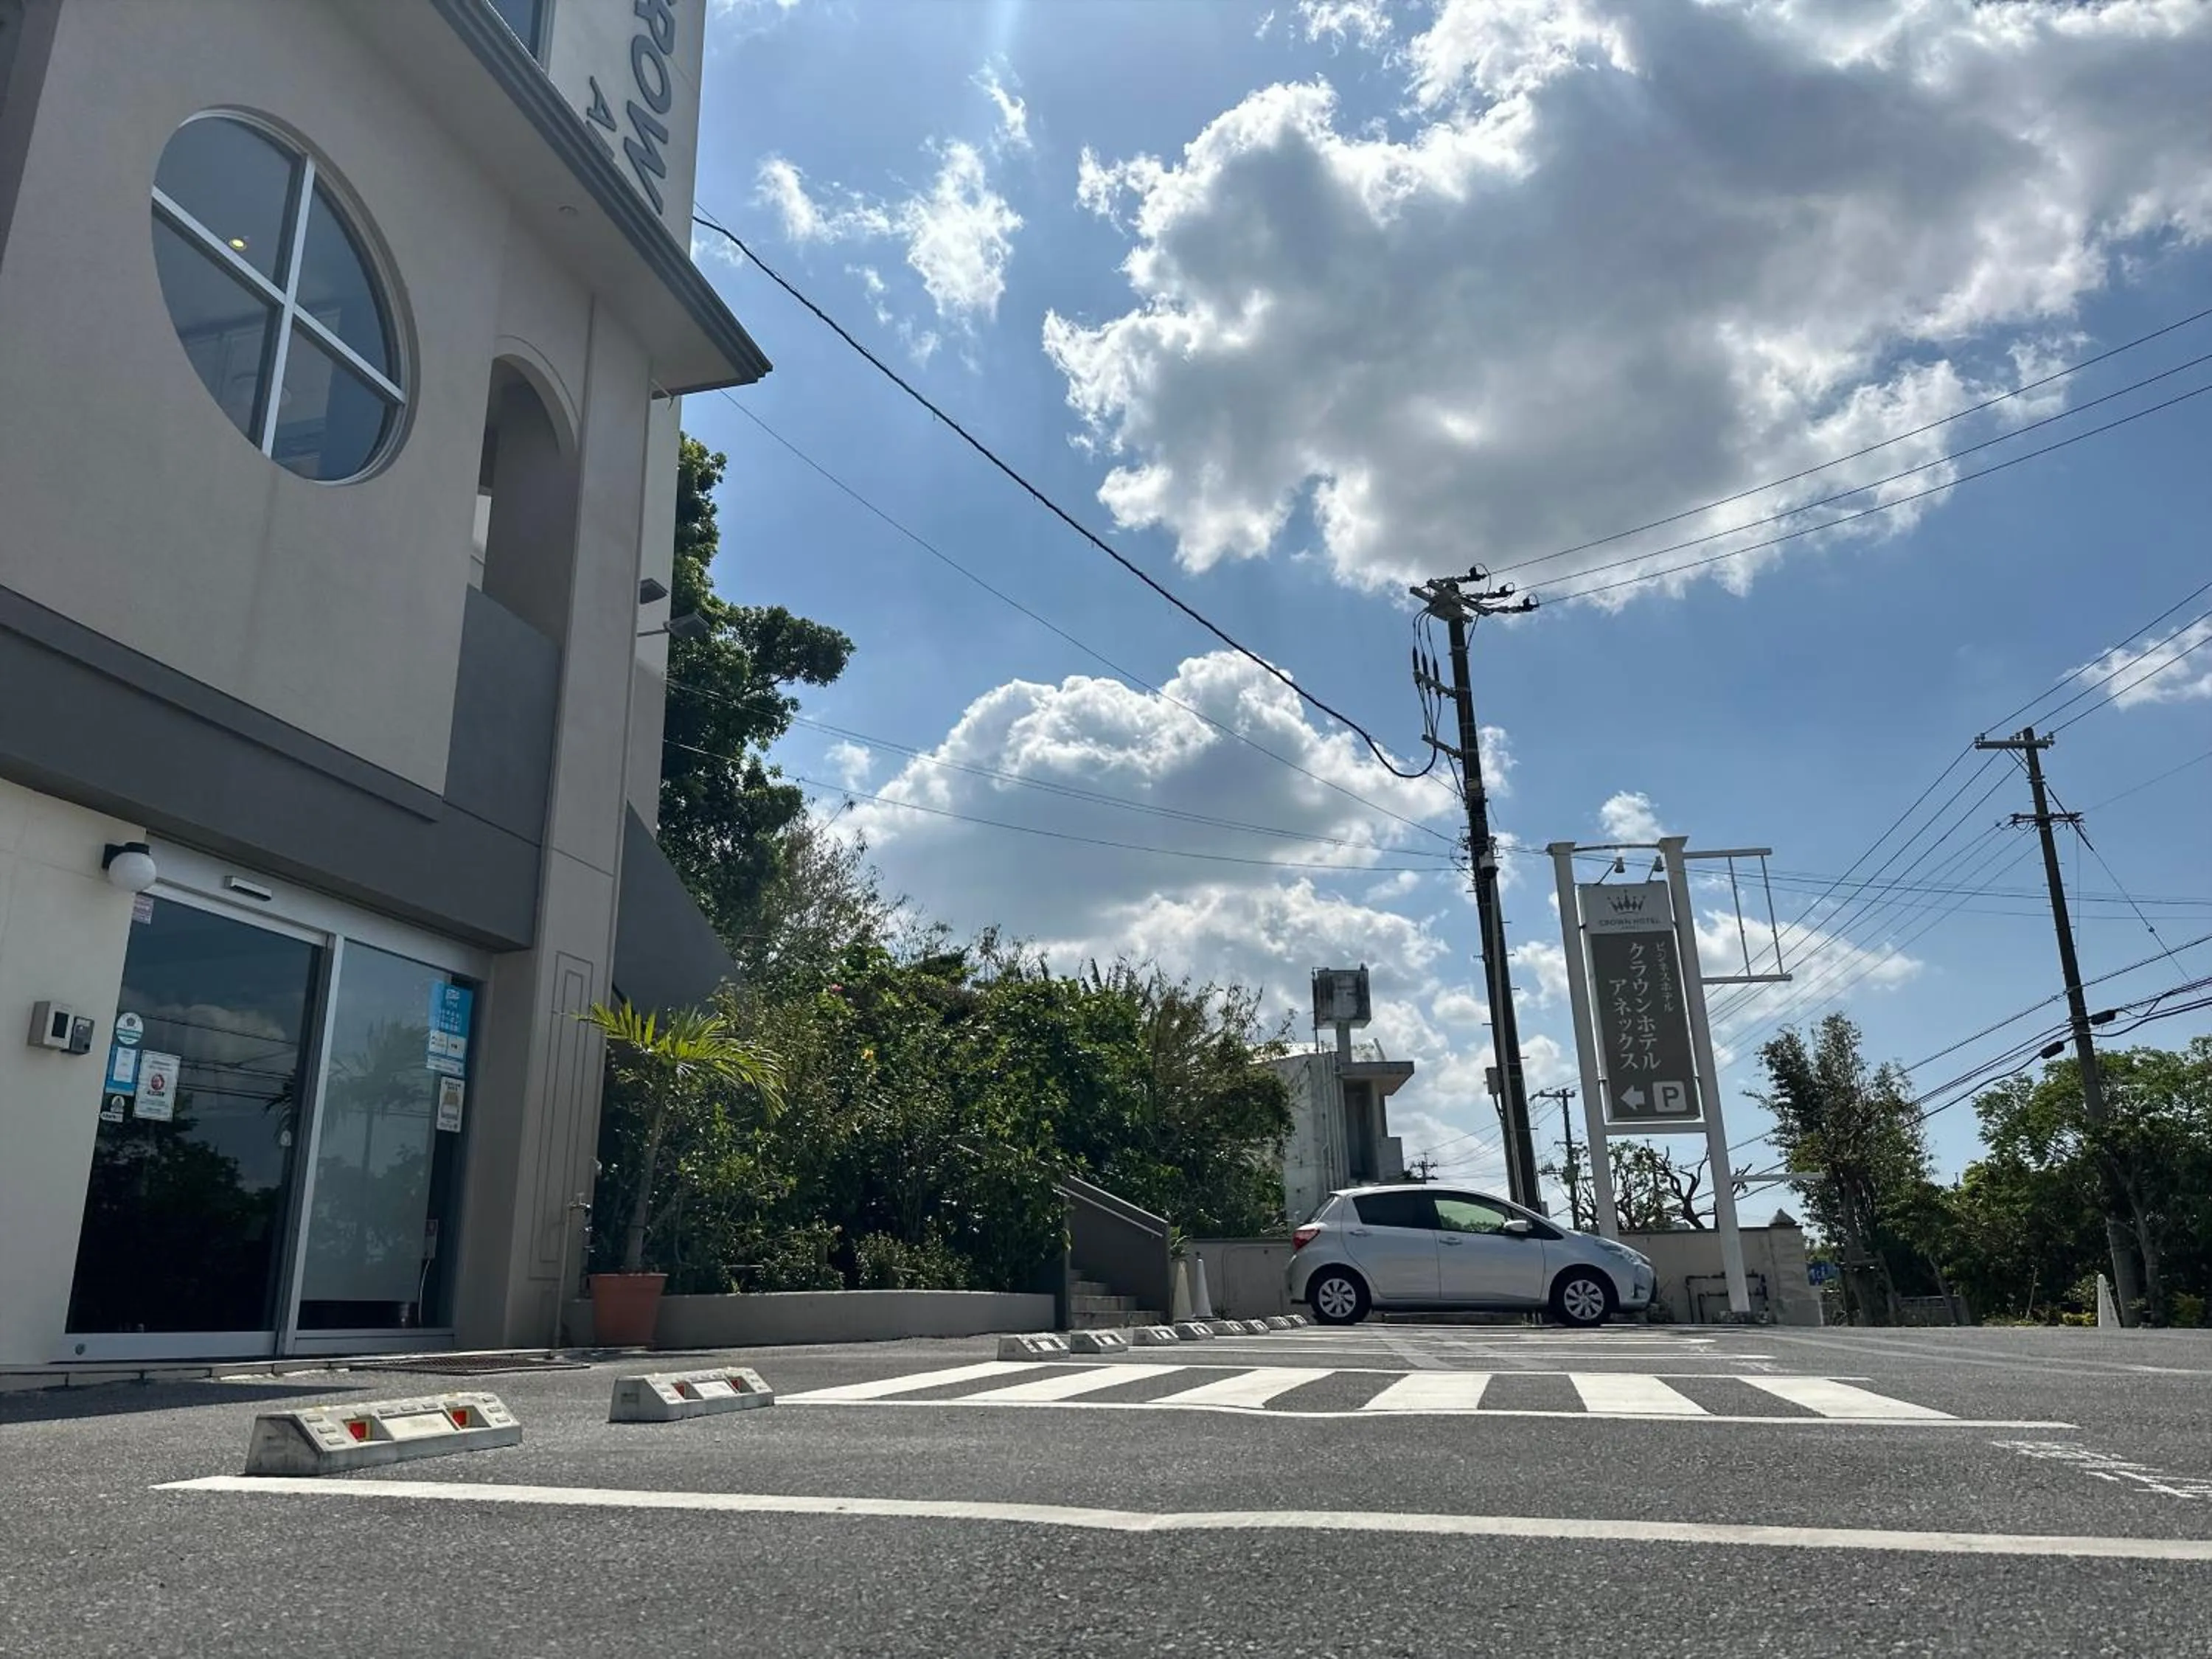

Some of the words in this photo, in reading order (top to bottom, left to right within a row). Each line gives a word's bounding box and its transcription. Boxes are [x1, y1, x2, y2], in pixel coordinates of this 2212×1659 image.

[625, 0, 677, 215] ROW
[1609, 978, 1638, 1071] アネックス
[1629, 942, 1661, 1071] クラウンホテル
[1662, 1086, 1680, 1107] P
